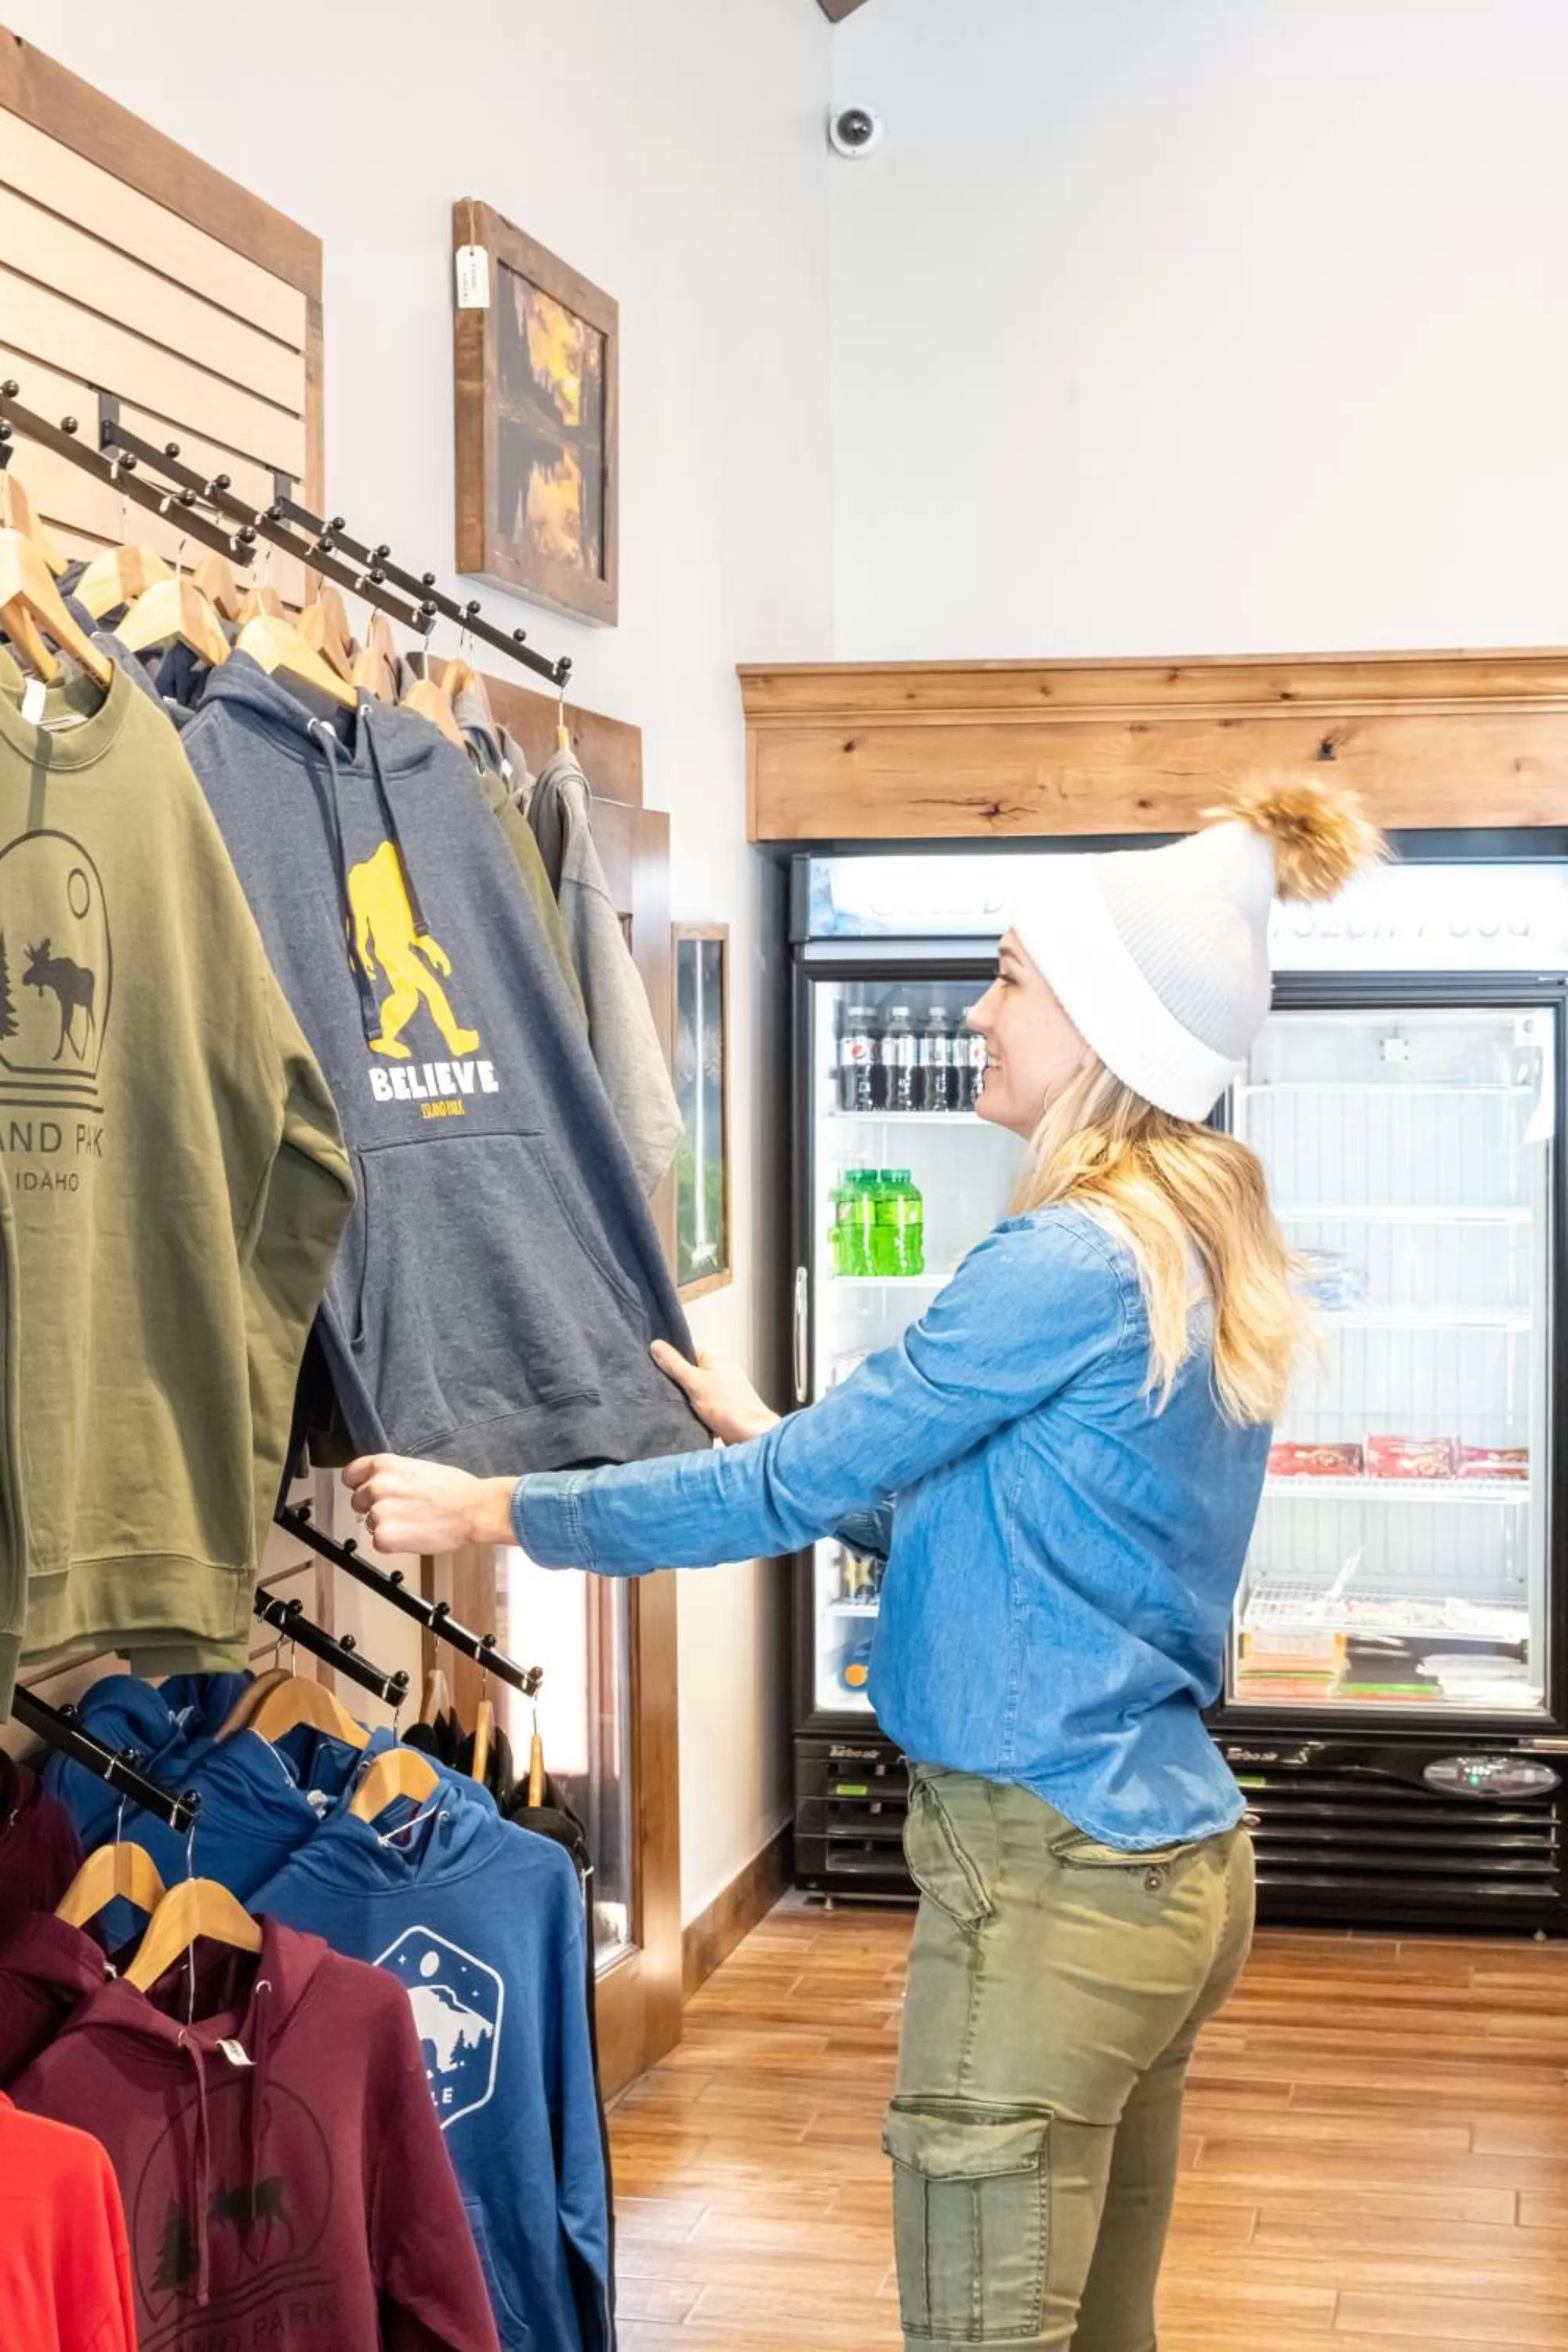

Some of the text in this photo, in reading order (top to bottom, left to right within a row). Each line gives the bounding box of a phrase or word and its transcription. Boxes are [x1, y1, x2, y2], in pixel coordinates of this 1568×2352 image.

[368, 1060, 499, 1102] BELIEVE
[0, 1120, 63, 1154] ND
[16, 1171, 79, 1192] IDAHO
[253, 2297, 337, 2346] PARK
